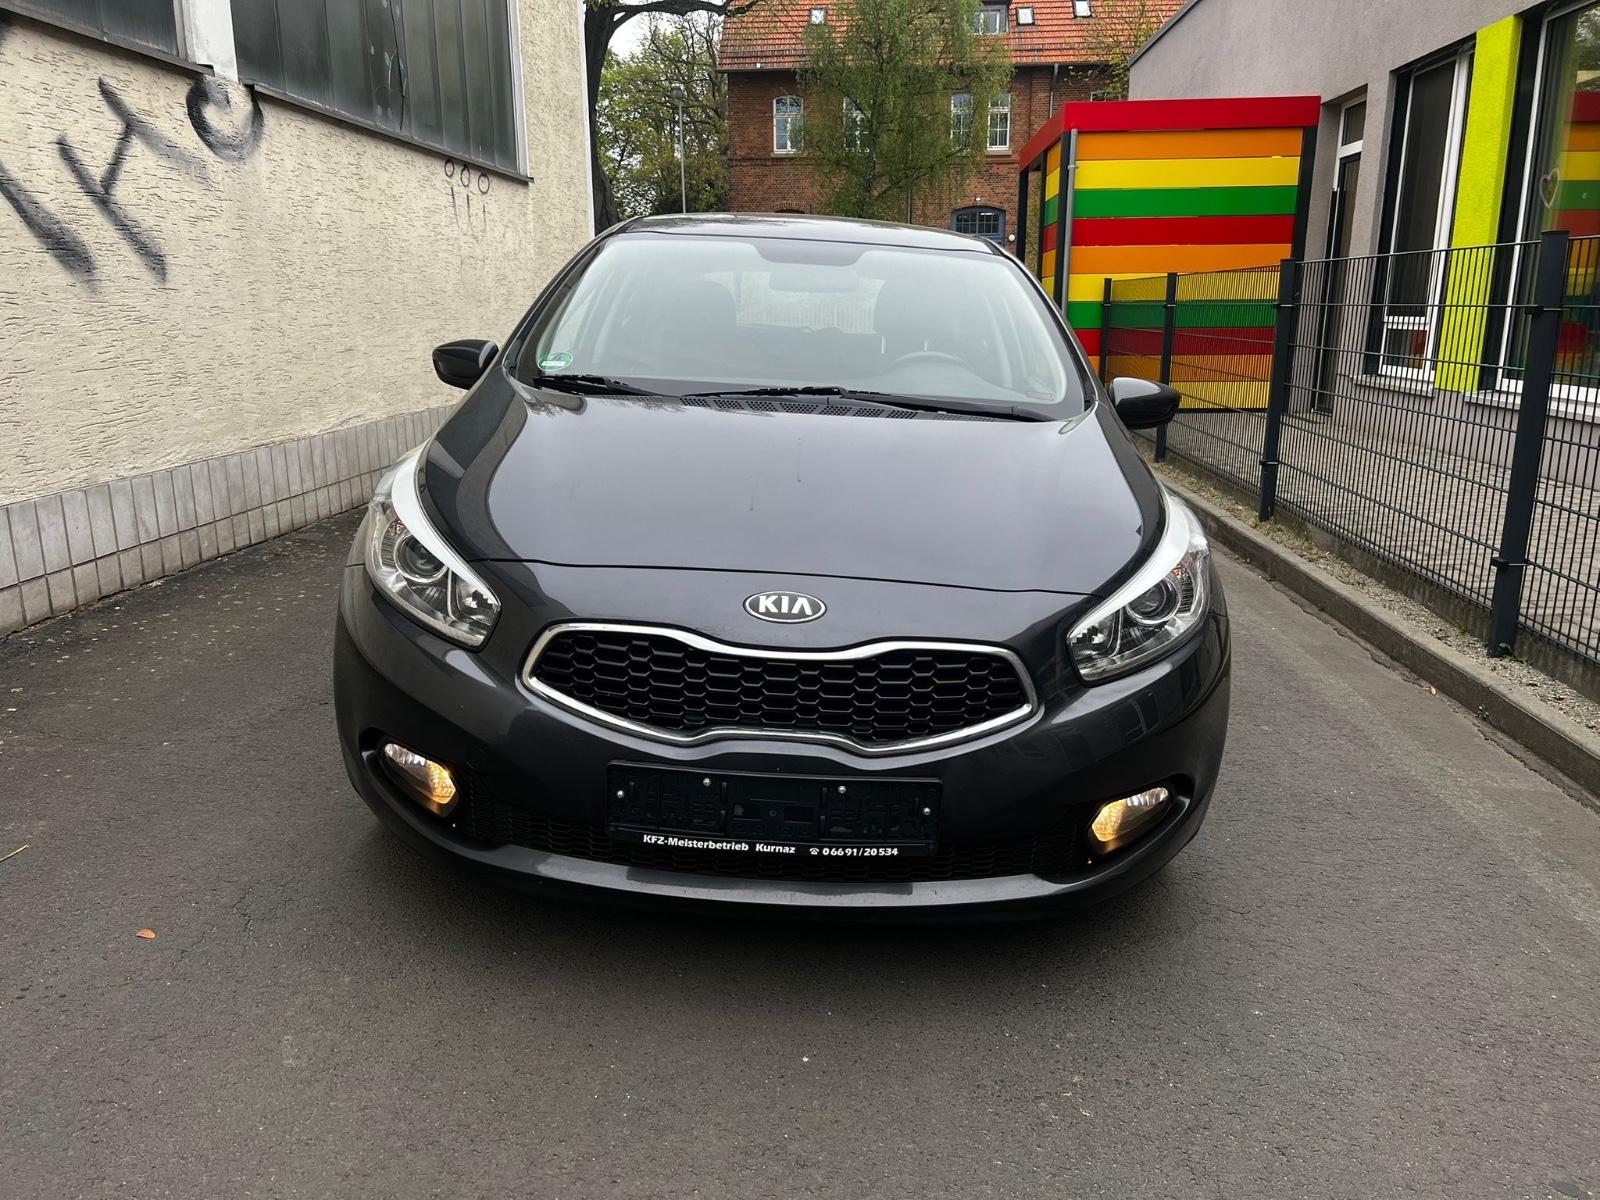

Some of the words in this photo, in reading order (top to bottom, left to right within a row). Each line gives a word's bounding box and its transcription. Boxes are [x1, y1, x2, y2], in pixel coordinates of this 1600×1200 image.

[758, 595, 813, 616] KIA
[643, 834, 749, 851] KFZ-Meisterbetrieb
[755, 843, 796, 853] Kurnaz
